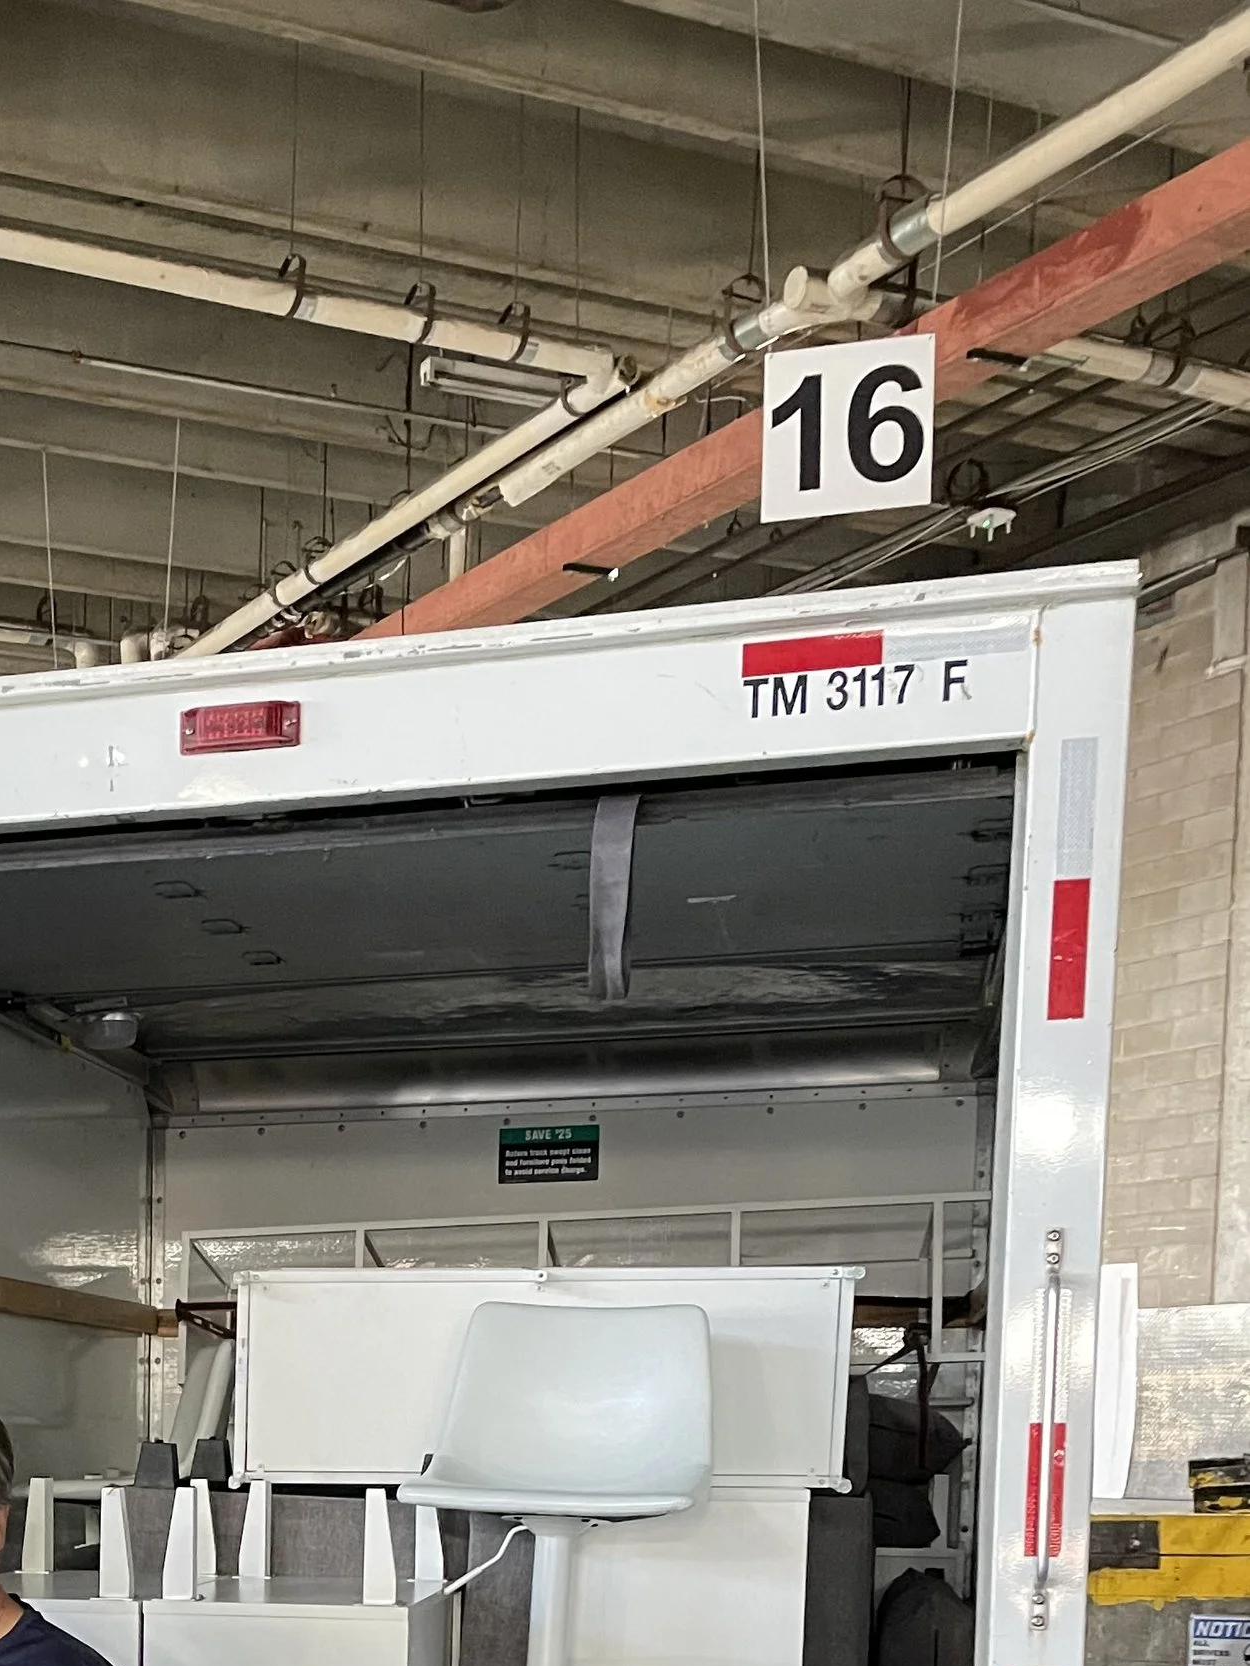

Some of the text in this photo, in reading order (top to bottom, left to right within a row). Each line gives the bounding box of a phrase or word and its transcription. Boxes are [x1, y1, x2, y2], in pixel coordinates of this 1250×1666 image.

[770, 363, 925, 491] 16
[743, 659, 969, 718] TM 3117 F
[525, 1129, 552, 1141] SAVE
